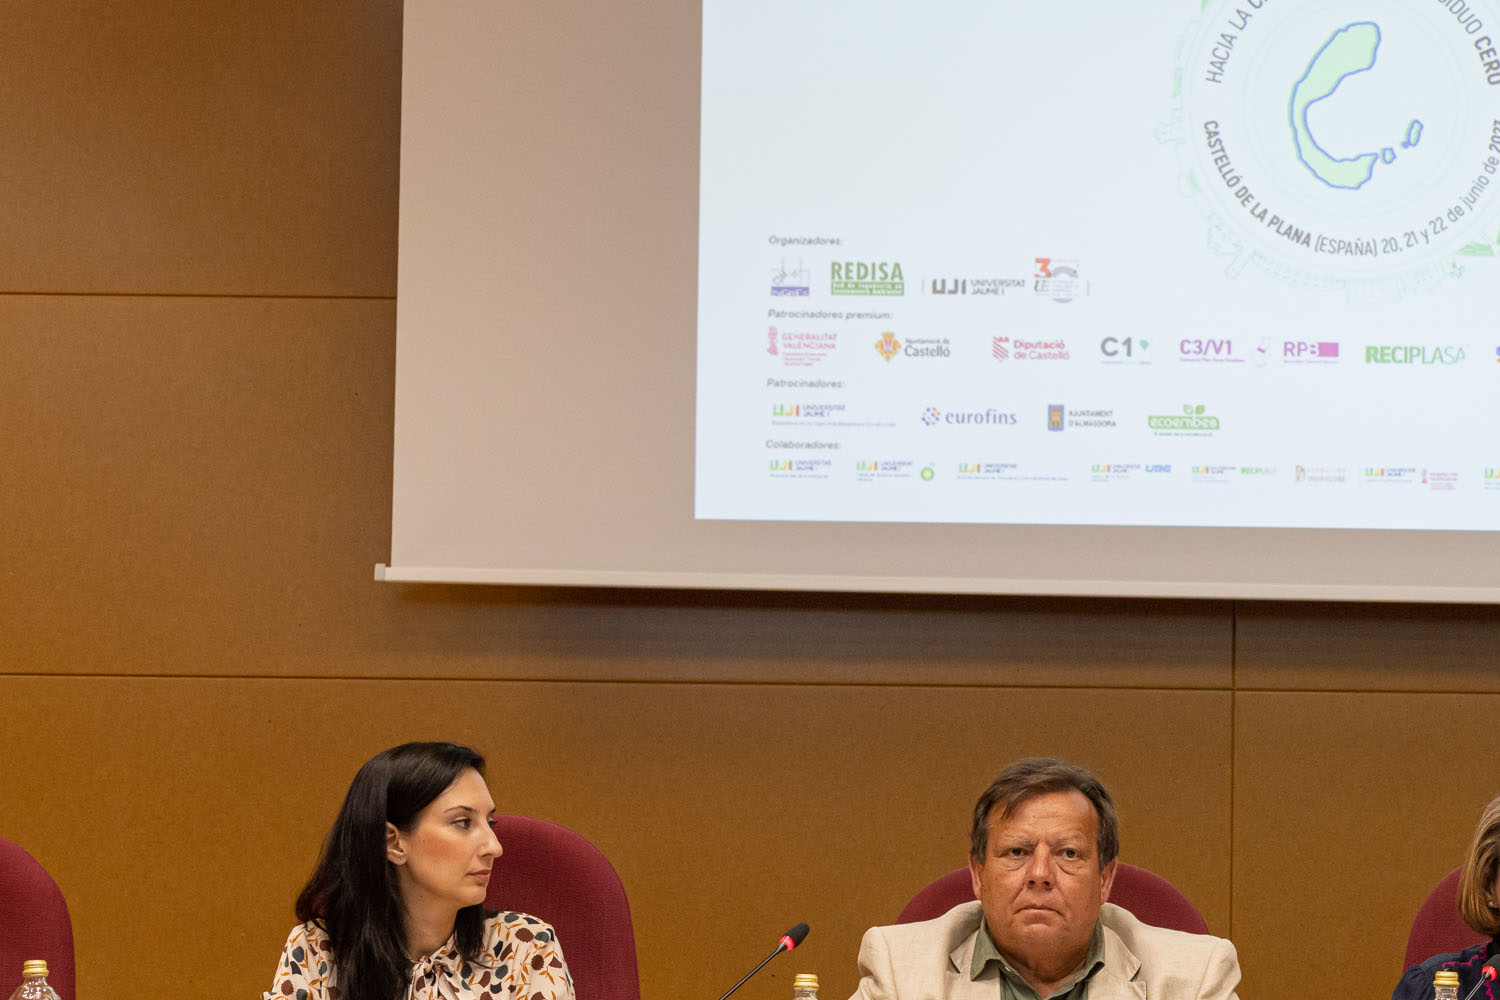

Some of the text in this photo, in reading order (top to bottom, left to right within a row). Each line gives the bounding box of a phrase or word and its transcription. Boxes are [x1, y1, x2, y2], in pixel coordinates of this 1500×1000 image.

[1206, 9, 1252, 84] HACIA LA
[1204, 120, 1240, 188] CASTELLÓ
[1234, 186, 1253, 208] DE
[1250, 200, 1269, 223] LA
[1267, 215, 1312, 248] PLANA
[1314, 234, 1378, 257] (ESPAÑA)
[1382, 239, 1403, 254] 20,
[1404, 230, 1419, 248] 21
[1420, 230, 1430, 243] y
[1428, 216, 1448, 235] 22
[1446, 203, 1465, 223] de
[1463, 175, 1491, 212] junio
[1484, 156, 1500, 175] de
[769, 236, 844, 247] Organizadores:
[831, 262, 903, 281] REDISA
[767, 309, 893, 321] Patrocinadores premium:
[904, 343, 950, 358] Castelló
[1013, 338, 1064, 351] Diputació
[1100, 337, 1133, 357] C1
[1180, 339, 1233, 356] C3/V1
[1013, 350, 1070, 361] de Castelló
[1365, 345, 1466, 364] RECIPLASA
[767, 378, 845, 389] Patrocinadores:
[945, 409, 1017, 425] eurofins
[765, 440, 842, 450] Colaboradores:
